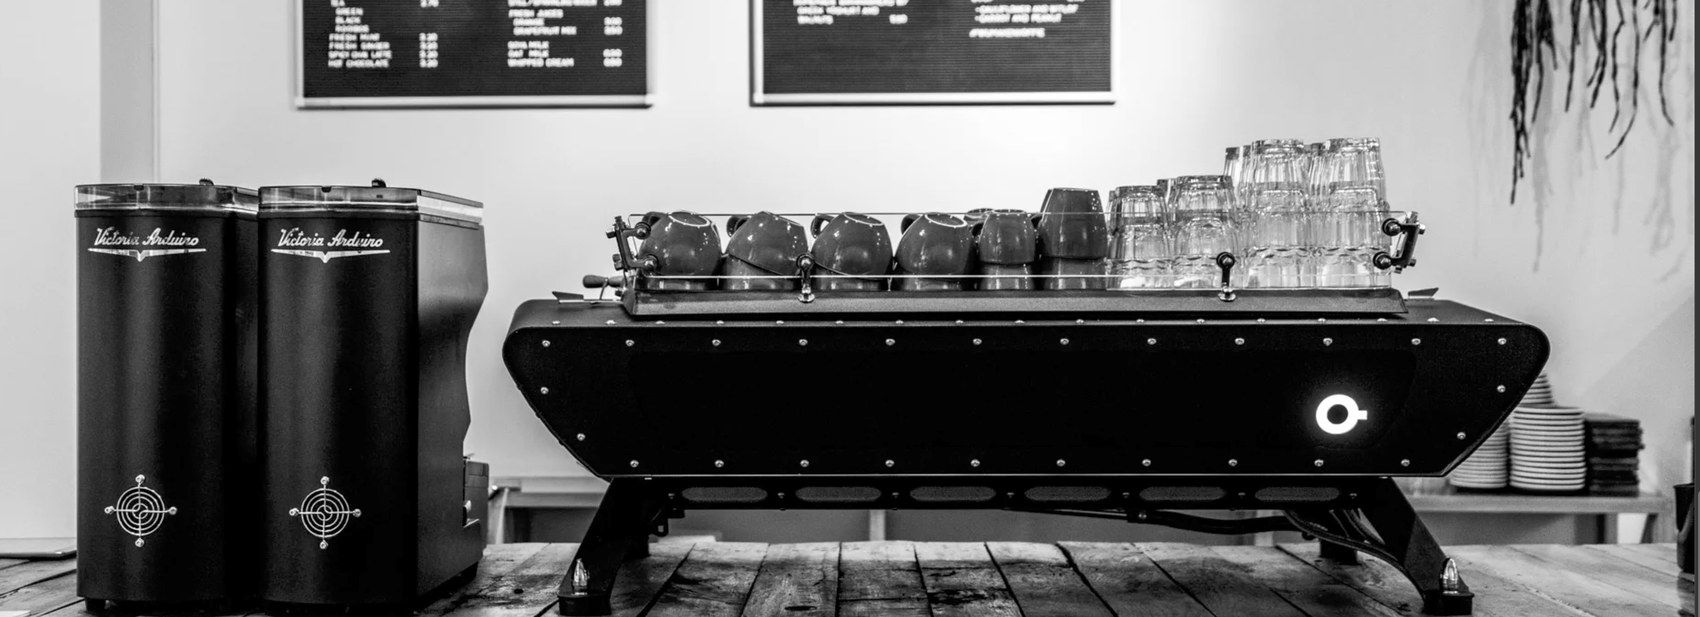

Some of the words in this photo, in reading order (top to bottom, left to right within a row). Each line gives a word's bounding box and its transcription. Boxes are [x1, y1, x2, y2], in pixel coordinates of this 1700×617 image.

[336, 7, 363, 15] GREEN
[335, 16, 361, 24] BLACK
[329, 33, 357, 41] FRESH
[360, 33, 380, 41] MINT
[529, 41, 549, 49] MILK
[328, 59, 343, 67] HOT
[346, 59, 388, 67] CHOCOLATE
[508, 58, 544, 67] WHIPPED
[546, 58, 574, 67] CREAM
[93, 226, 140, 246] Victoria
[142, 227, 199, 246] Arduino
[277, 227, 324, 248] Victoria
[327, 228, 384, 248] Arduino
